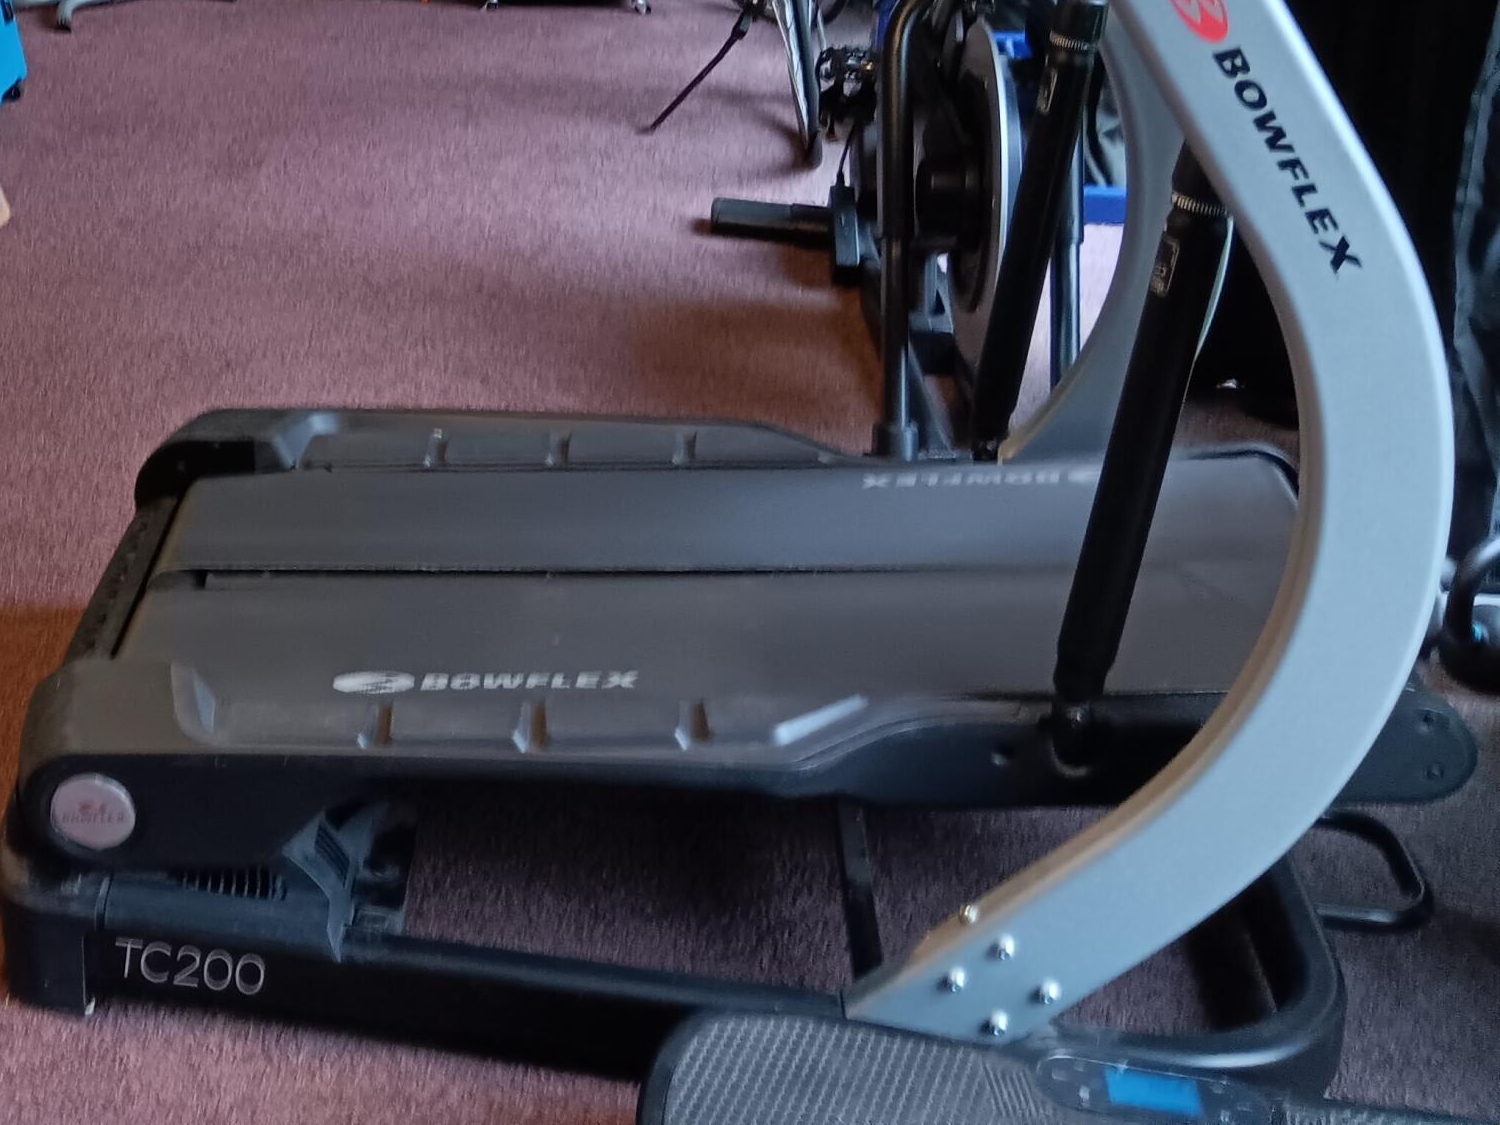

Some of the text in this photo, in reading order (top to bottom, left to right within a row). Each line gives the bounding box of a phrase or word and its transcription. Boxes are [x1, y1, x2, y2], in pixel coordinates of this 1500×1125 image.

[1212, 46, 1363, 278] BOWFLEX
[420, 671, 638, 691] BOWFLEX
[115, 937, 265, 996] TC200
